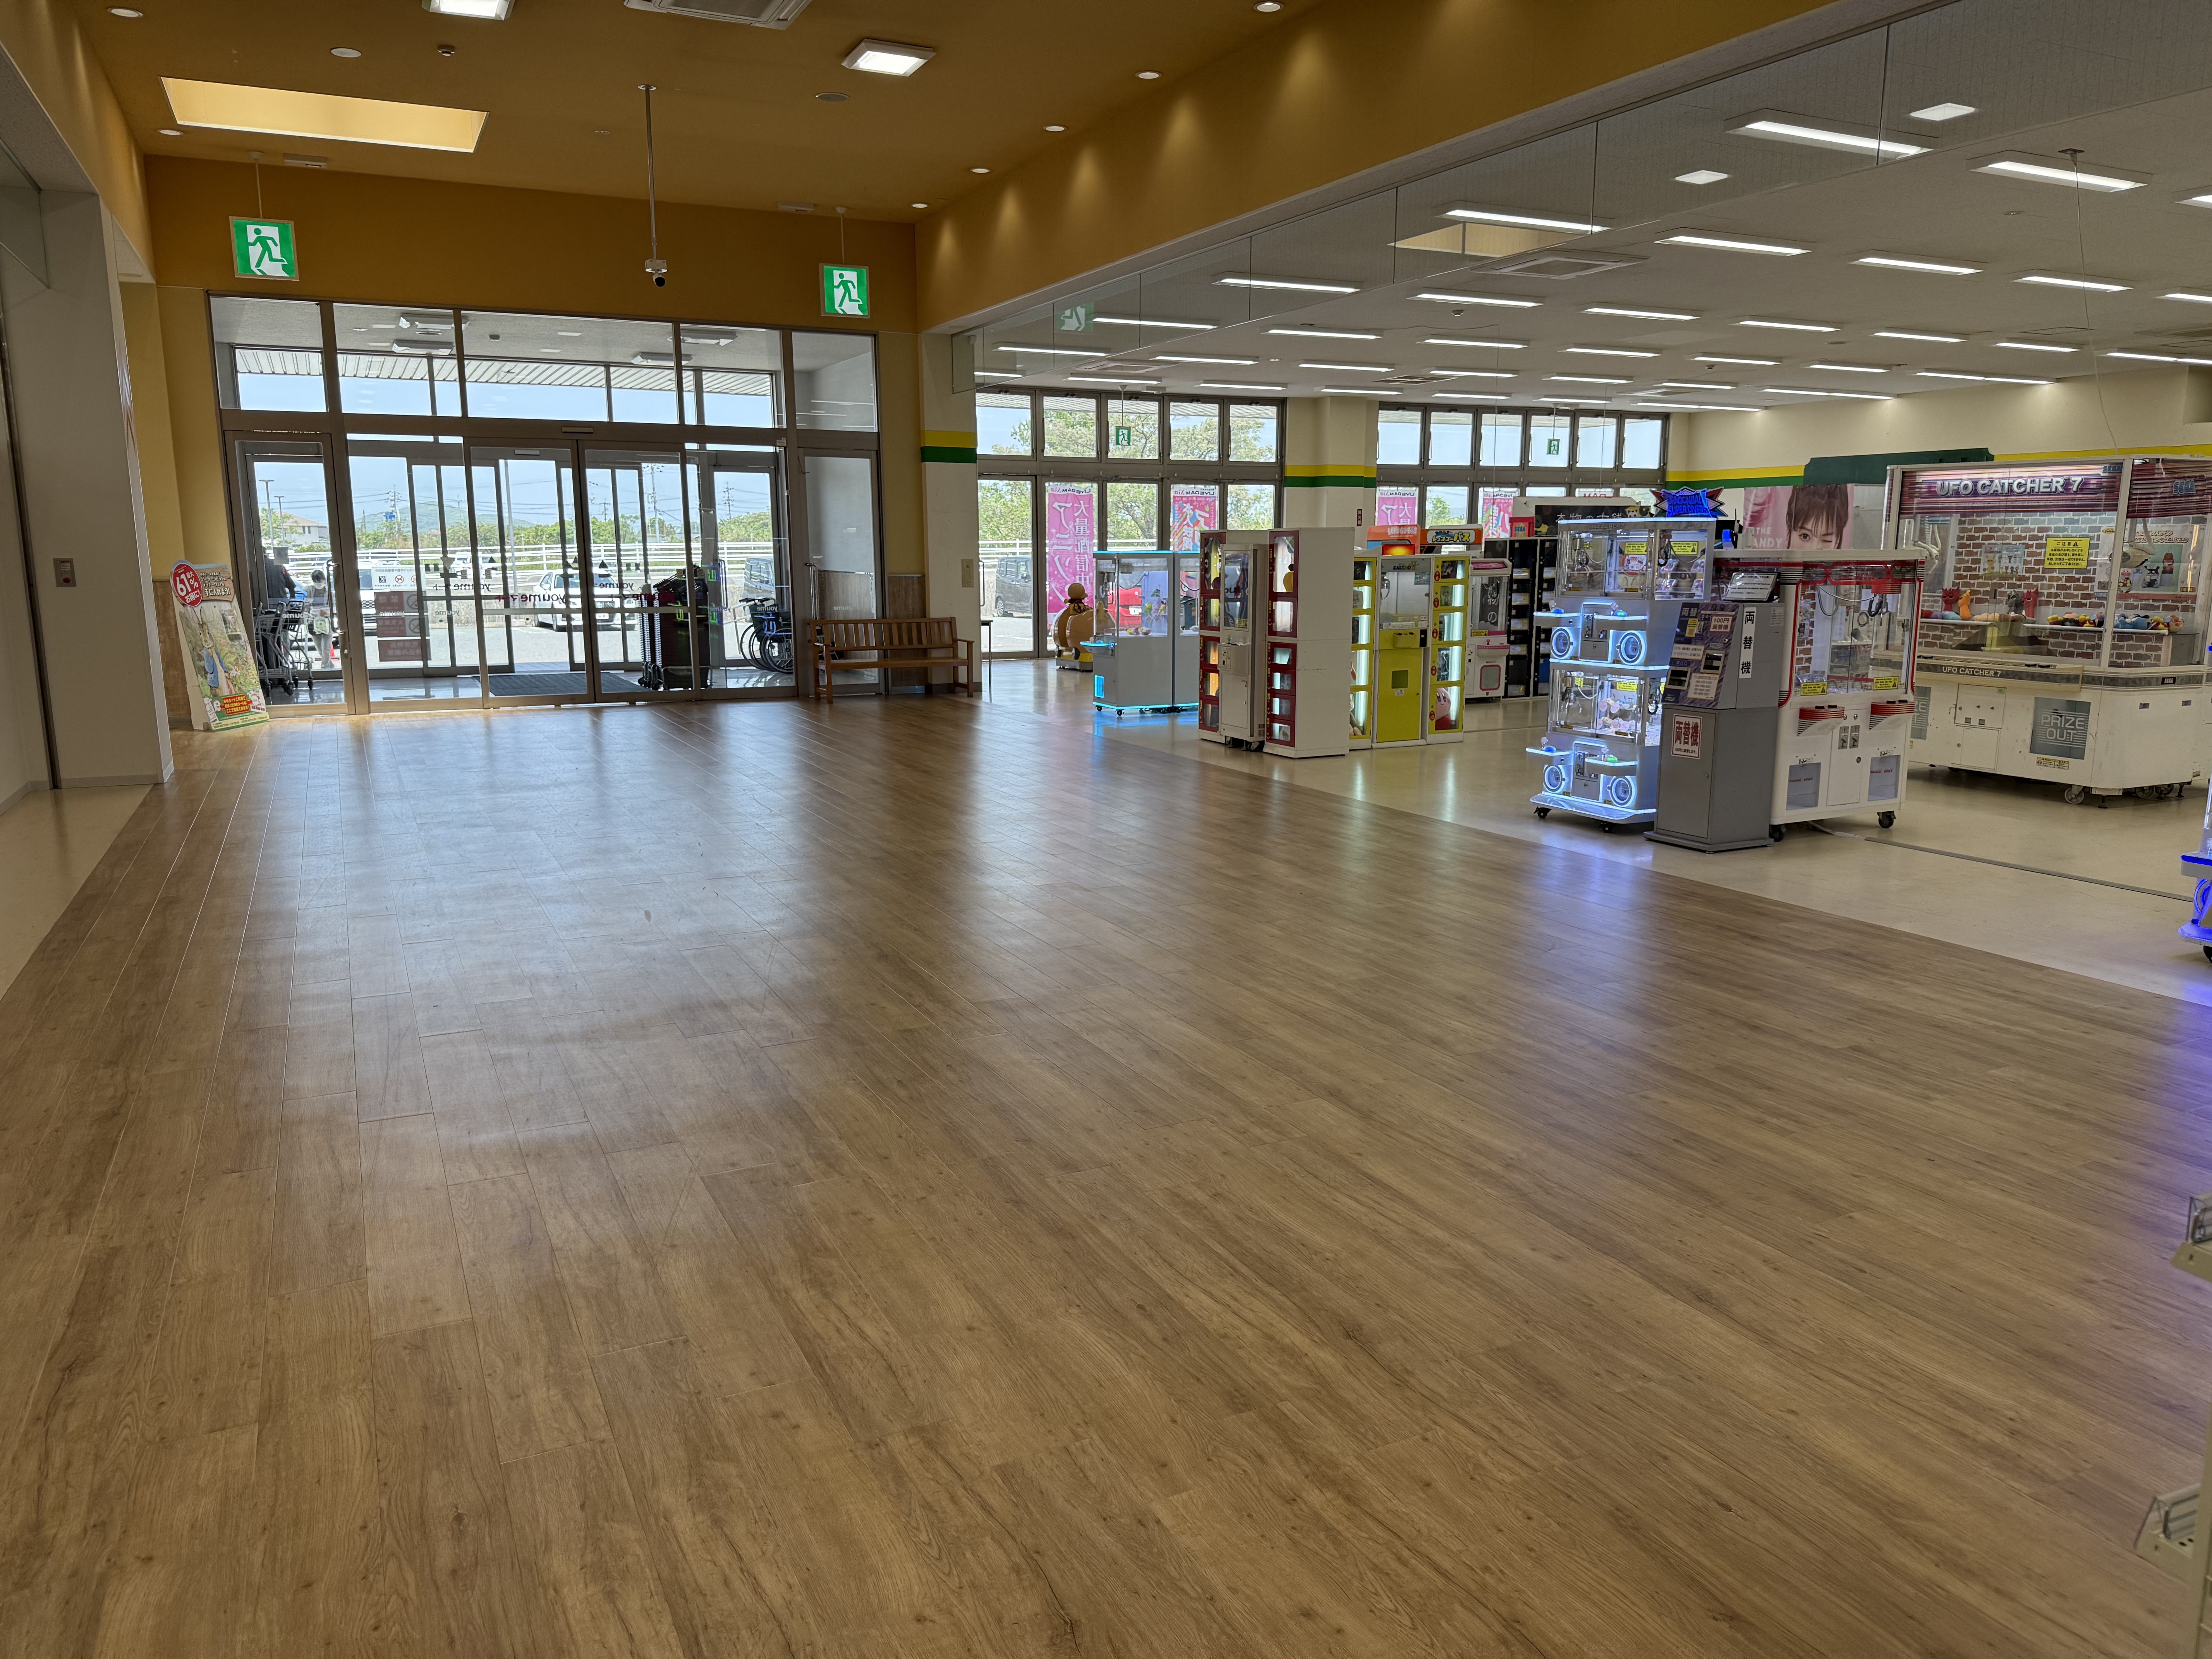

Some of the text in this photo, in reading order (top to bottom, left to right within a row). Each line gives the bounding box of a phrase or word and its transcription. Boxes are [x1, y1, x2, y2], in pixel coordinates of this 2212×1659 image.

[1936, 476, 2084, 496] UFO CATCHER 7
[2172, 480, 2196, 495] SEGA
[1752, 537, 1782, 548] ANDY
[185, 589, 201, 603] お得に!
[204, 588, 231, 597] 手に入れよう!
[1740, 611, 1755, 674] 両替機
[1960, 668, 1994, 677] CATCHER
[2041, 714, 2085, 729] PRIZE
[1675, 721, 1699, 747] 両替機
[2046, 728, 2077, 742] OUT
